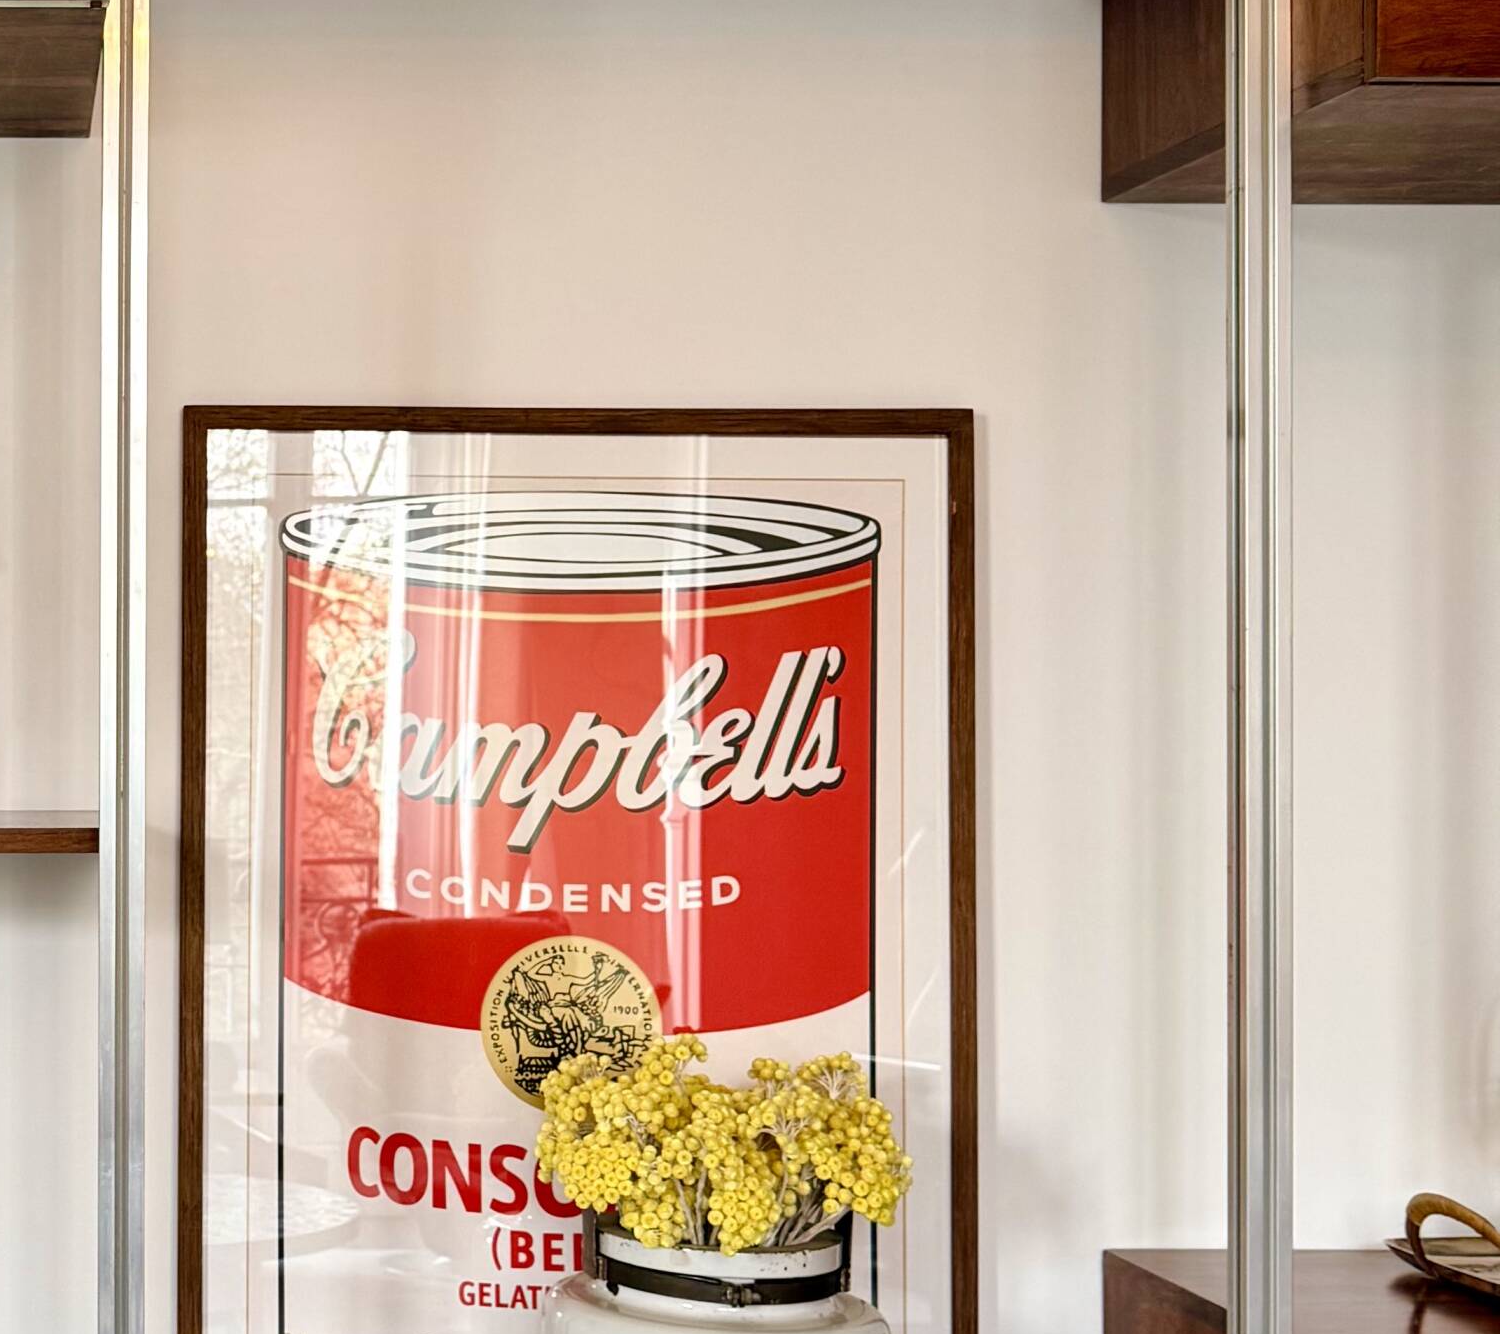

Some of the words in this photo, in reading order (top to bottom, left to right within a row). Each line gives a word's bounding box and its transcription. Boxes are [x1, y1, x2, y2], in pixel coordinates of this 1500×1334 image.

[308, 622, 846, 853] Campbell's
[405, 867, 741, 914] CONDENSED
[489, 990, 508, 1064] EXPOSITION
[613, 1005, 639, 1015] 1900
[459, 1280, 550, 1310] GELAT
